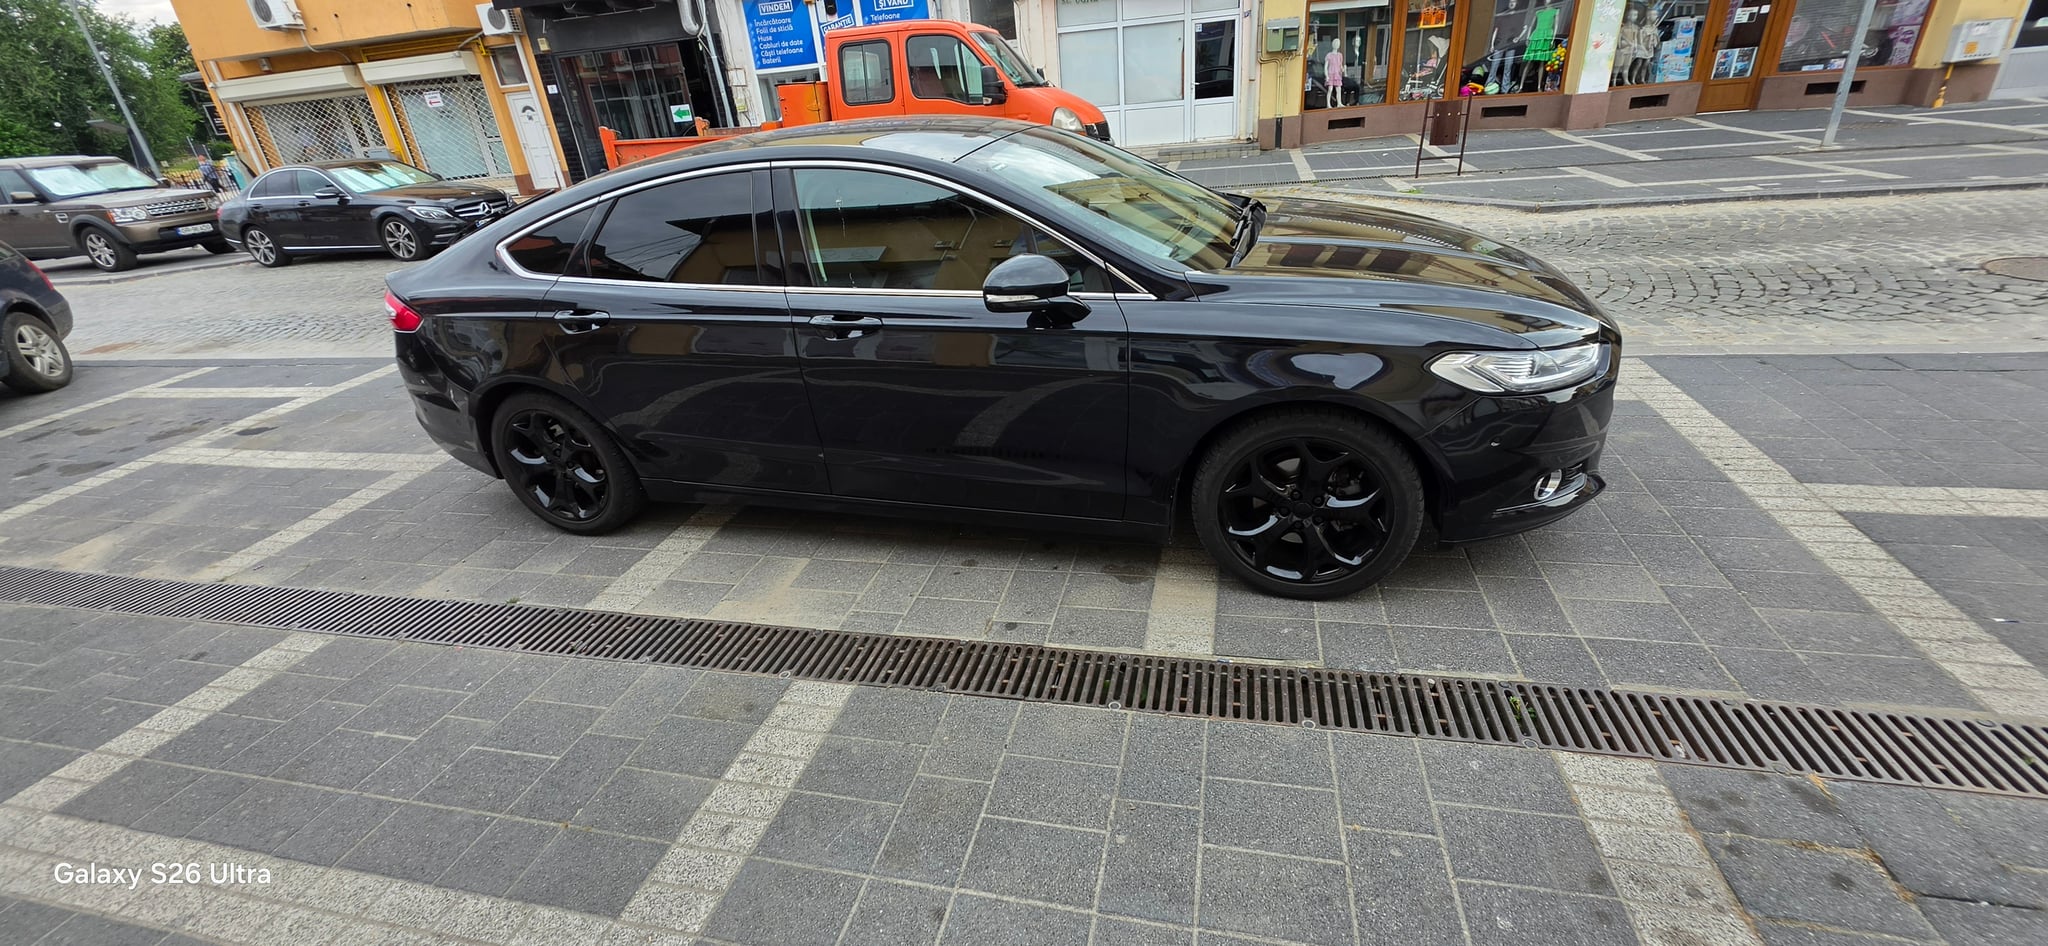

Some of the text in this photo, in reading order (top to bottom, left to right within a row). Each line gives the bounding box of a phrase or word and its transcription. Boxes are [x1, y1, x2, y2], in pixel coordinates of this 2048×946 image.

[761, 2, 790, 13] VINDEM
[870, 13, 900, 21] Telefoane
[759, 41, 781, 50] Cabluri
